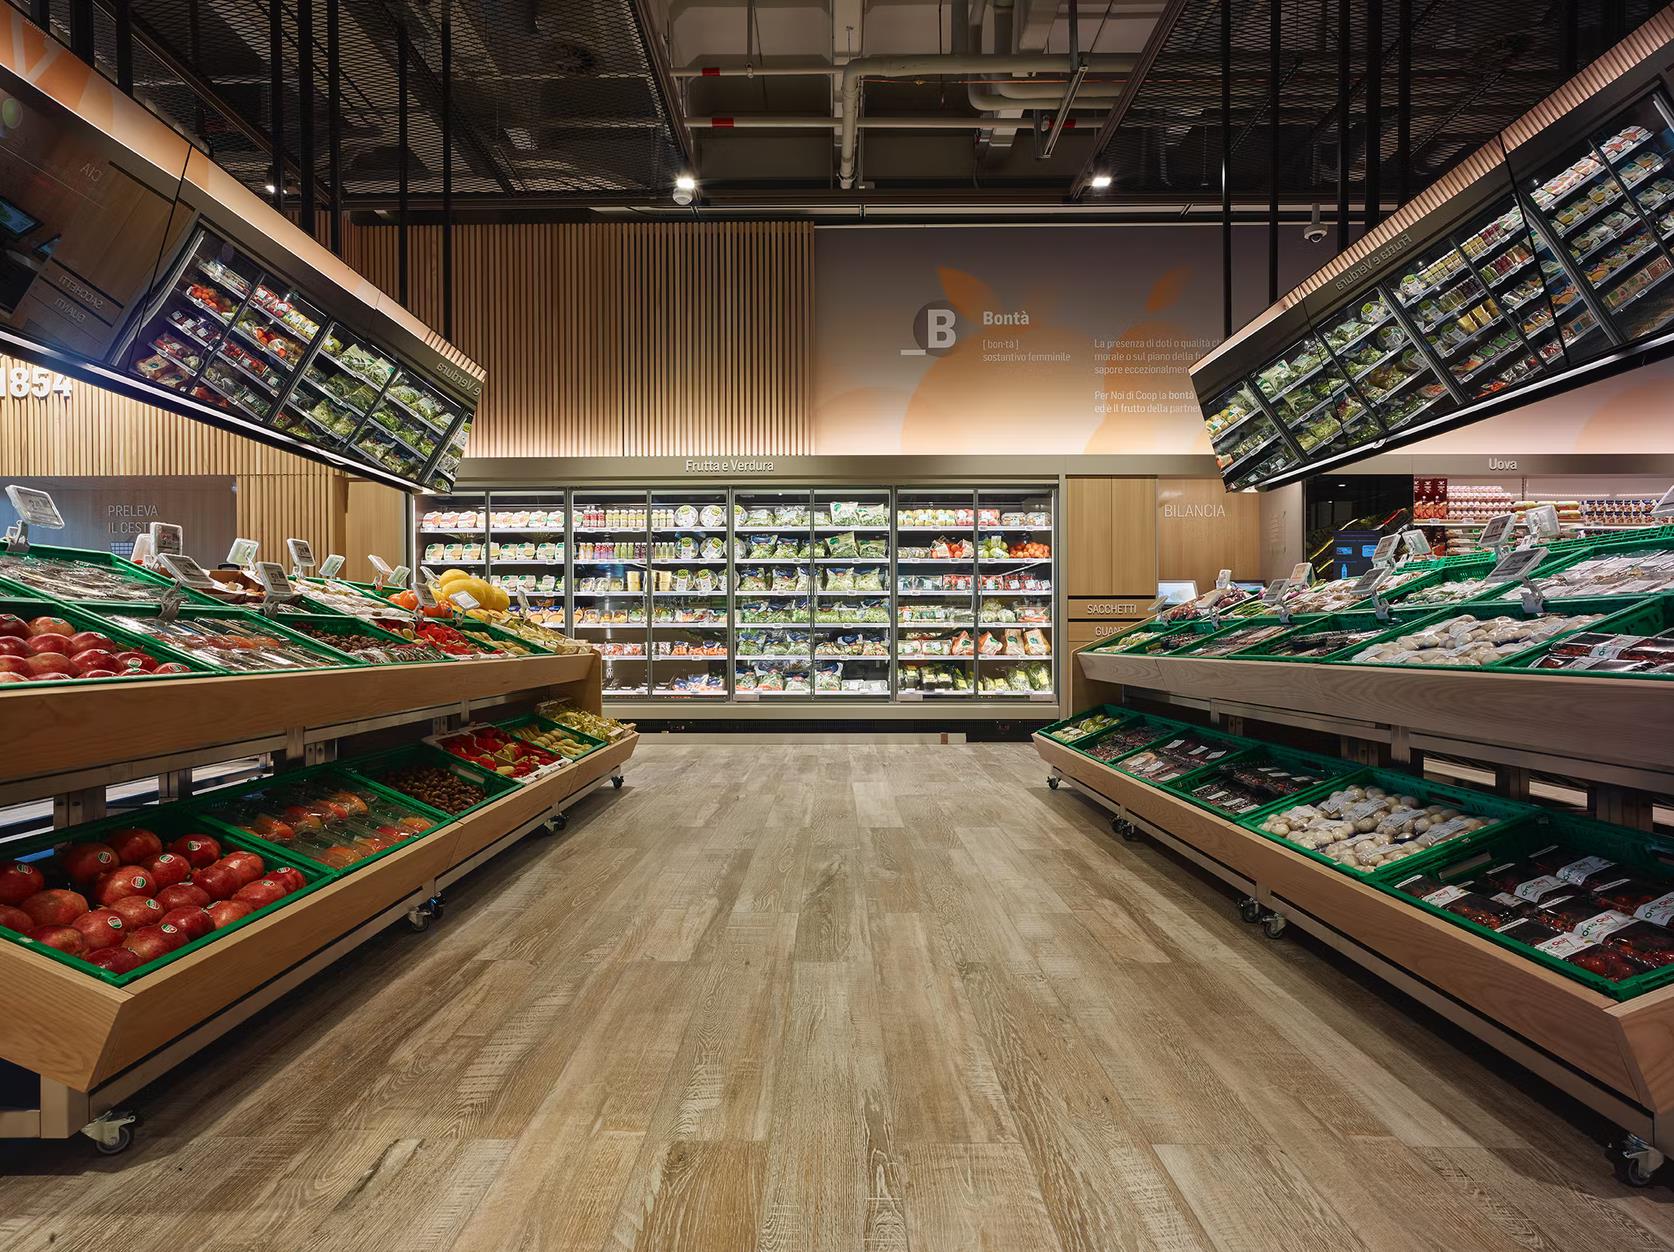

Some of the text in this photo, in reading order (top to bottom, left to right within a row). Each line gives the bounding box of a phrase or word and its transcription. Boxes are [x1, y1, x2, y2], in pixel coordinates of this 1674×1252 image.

[983, 310, 1030, 325] Bontà
[1094, 339, 1105, 348] La
[1107, 340, 1145, 350] presenza
[1146, 339, 1154, 348] di
[1155, 339, 1172, 348] doti
[1180, 338, 1210, 350] qualità
[983, 352, 1071, 362] sostantivo femminile
[1094, 352, 1125, 361] morale
[1133, 352, 1146, 361] sul
[1147, 352, 1171, 363] piano
[1172, 352, 1194, 361] della
[1094, 365, 1188, 376] sapore eccezionalmen
[1094, 390, 1194, 403] Per Noi di Coop la bontà
[1094, 404, 1105, 413] ed
[1120, 403, 1146, 413] frutto
[1147, 403, 1168, 413] della
[686, 459, 775, 472] Frutta e Verdura
[1488, 457, 1518, 470] Uova
[108, 504, 158, 517] PRELEVA
[1164, 504, 1226, 518] BILANCIA
[108, 522, 149, 533] IL CEST
[1087, 604, 1137, 615] SACCHETTI
